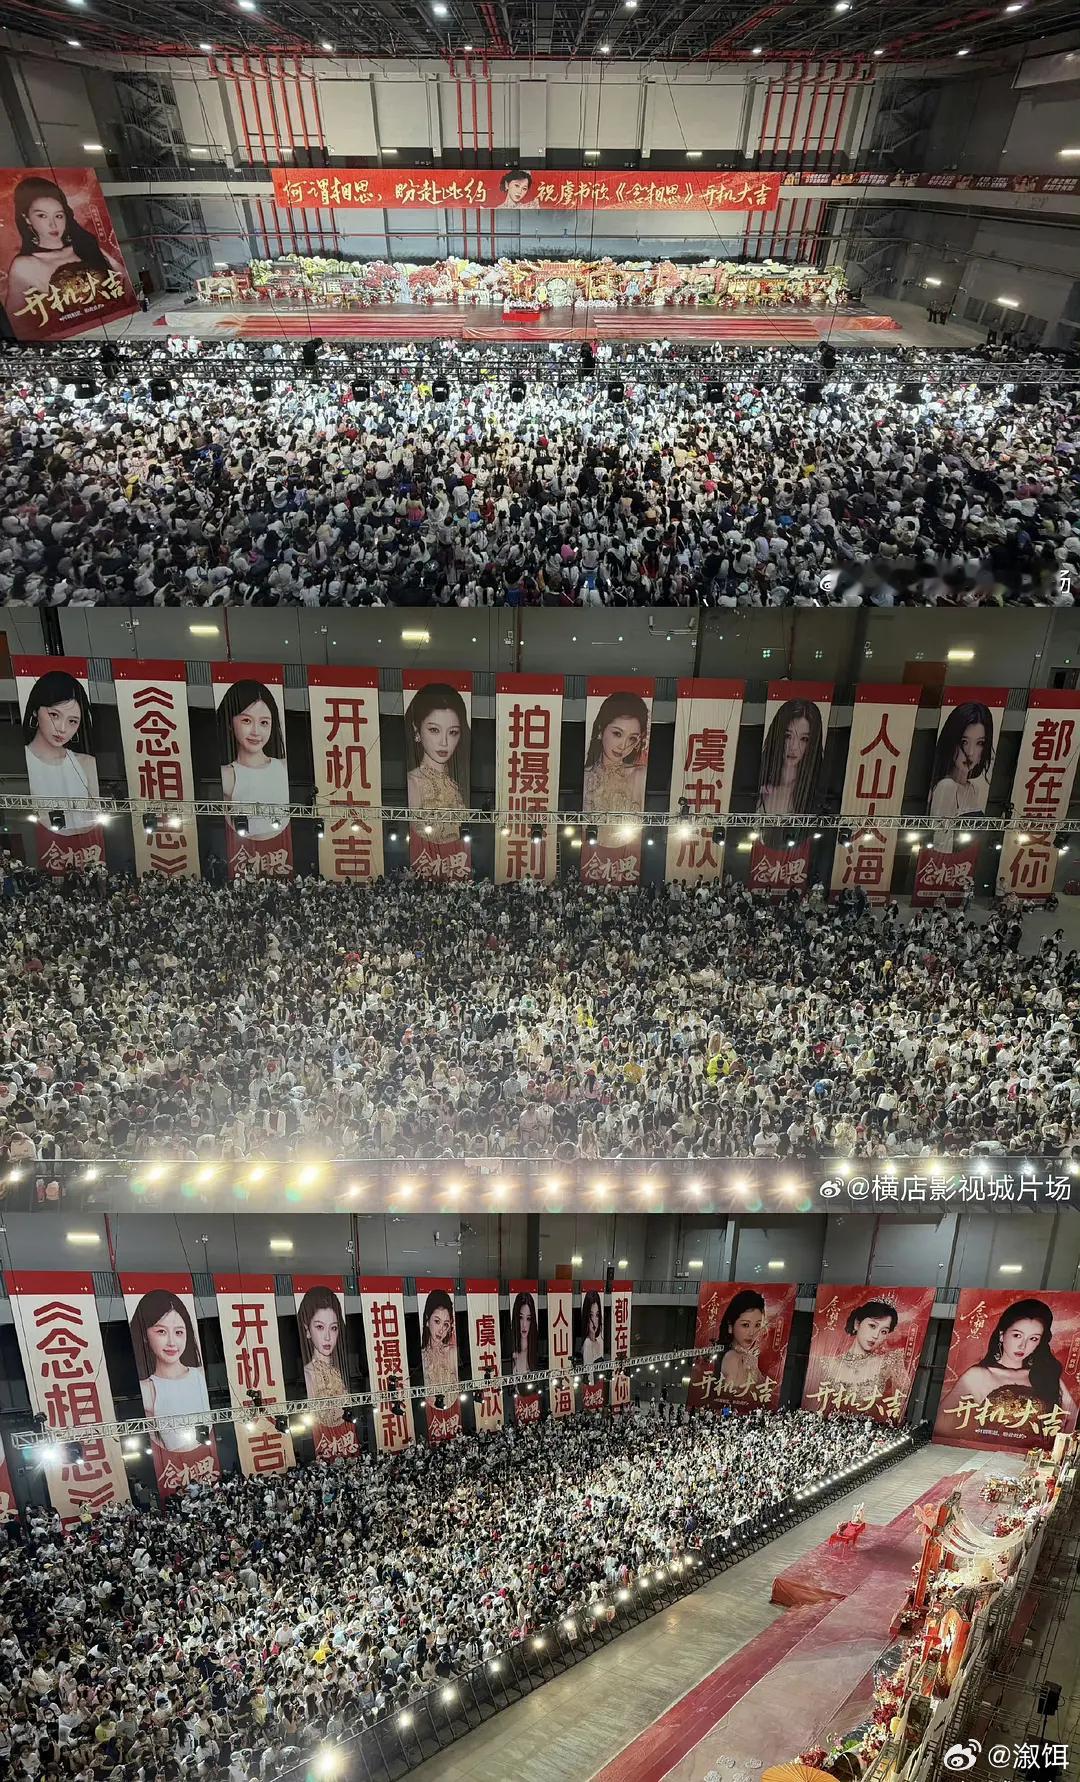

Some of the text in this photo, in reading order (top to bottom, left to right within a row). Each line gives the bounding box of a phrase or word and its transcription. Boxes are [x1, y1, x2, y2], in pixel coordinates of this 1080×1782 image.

[13, 269, 125, 328] 开机大吉
[323, 698, 373, 877] 开机大吉
[507, 703, 551, 880] 拍摄顺利
[229, 845, 293, 876] 念相思
[410, 848, 472, 881] 念相思
[581, 851, 640, 883] 念相思
[751, 855, 808, 885] 念相思
[917, 857, 976, 886] 念相思
[692, 1370, 778, 1403] 开机大吉
[805, 1380, 908, 1419] 开机大吉
[943, 1394, 1071, 1437] 开机大吉
